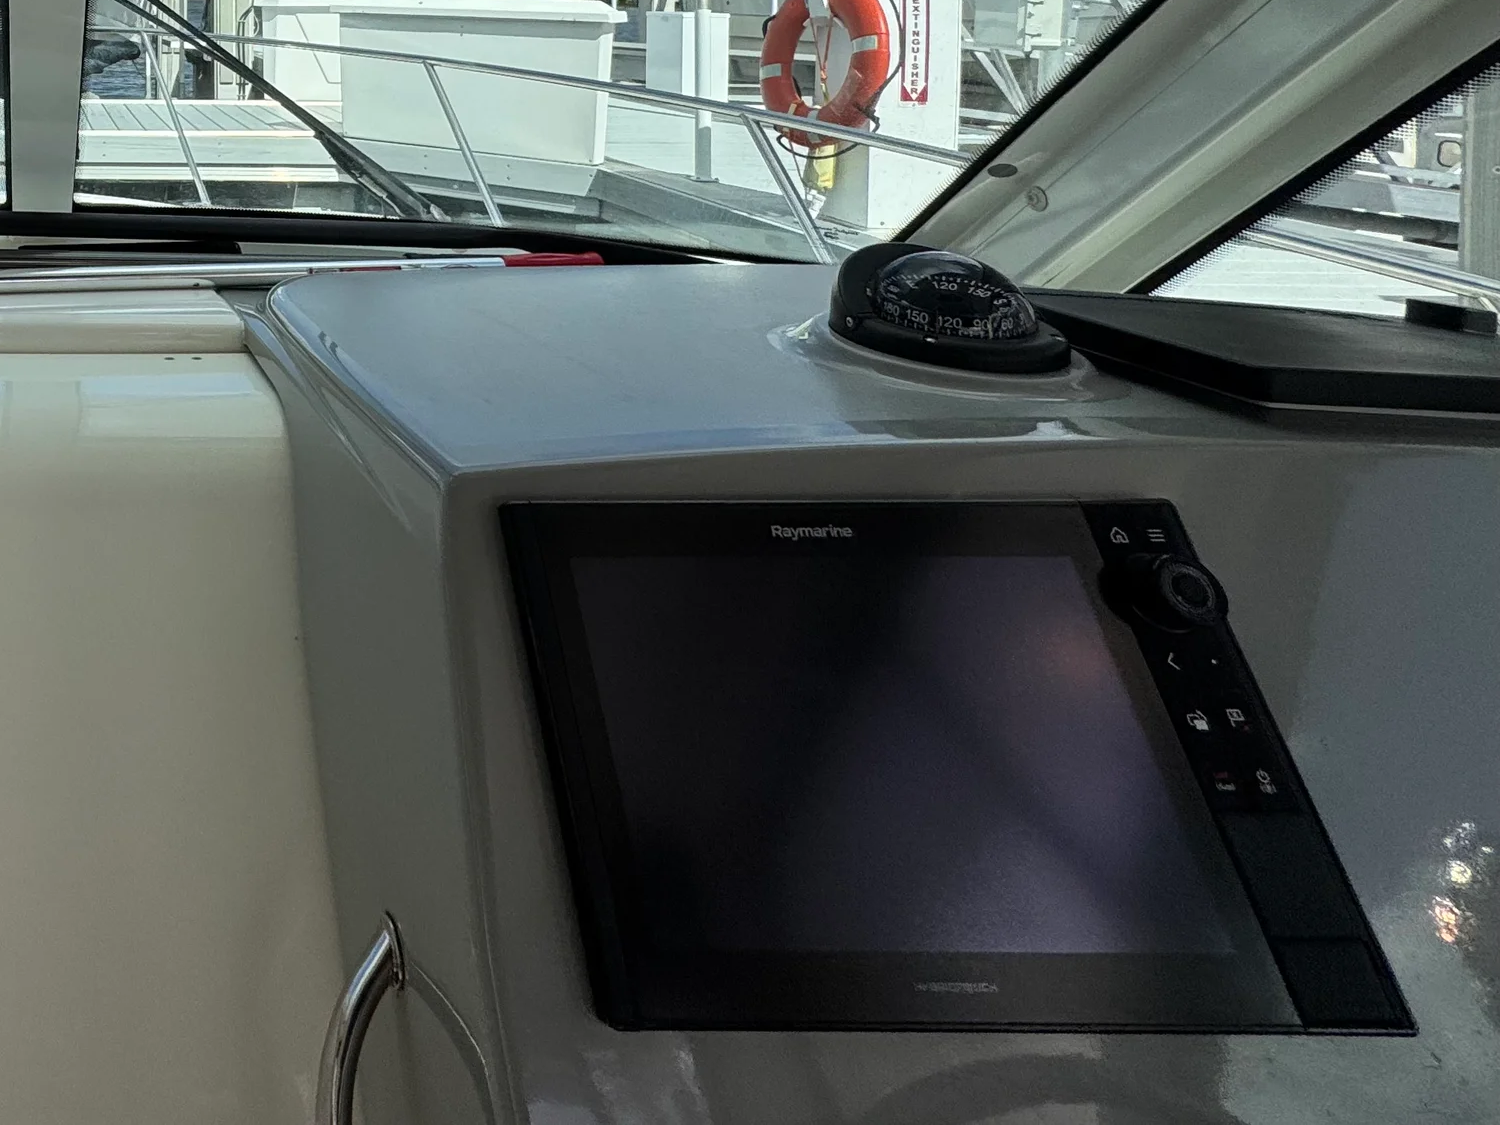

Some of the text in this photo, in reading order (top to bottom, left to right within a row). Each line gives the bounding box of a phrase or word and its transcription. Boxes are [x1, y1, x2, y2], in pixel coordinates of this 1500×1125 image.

[932, 281, 958, 291] 120
[967, 286, 992, 298] 150
[905, 308, 929, 324] 150
[937, 315, 963, 329] 120
[973, 319, 991, 331] 90
[770, 524, 854, 541] Raymarine
